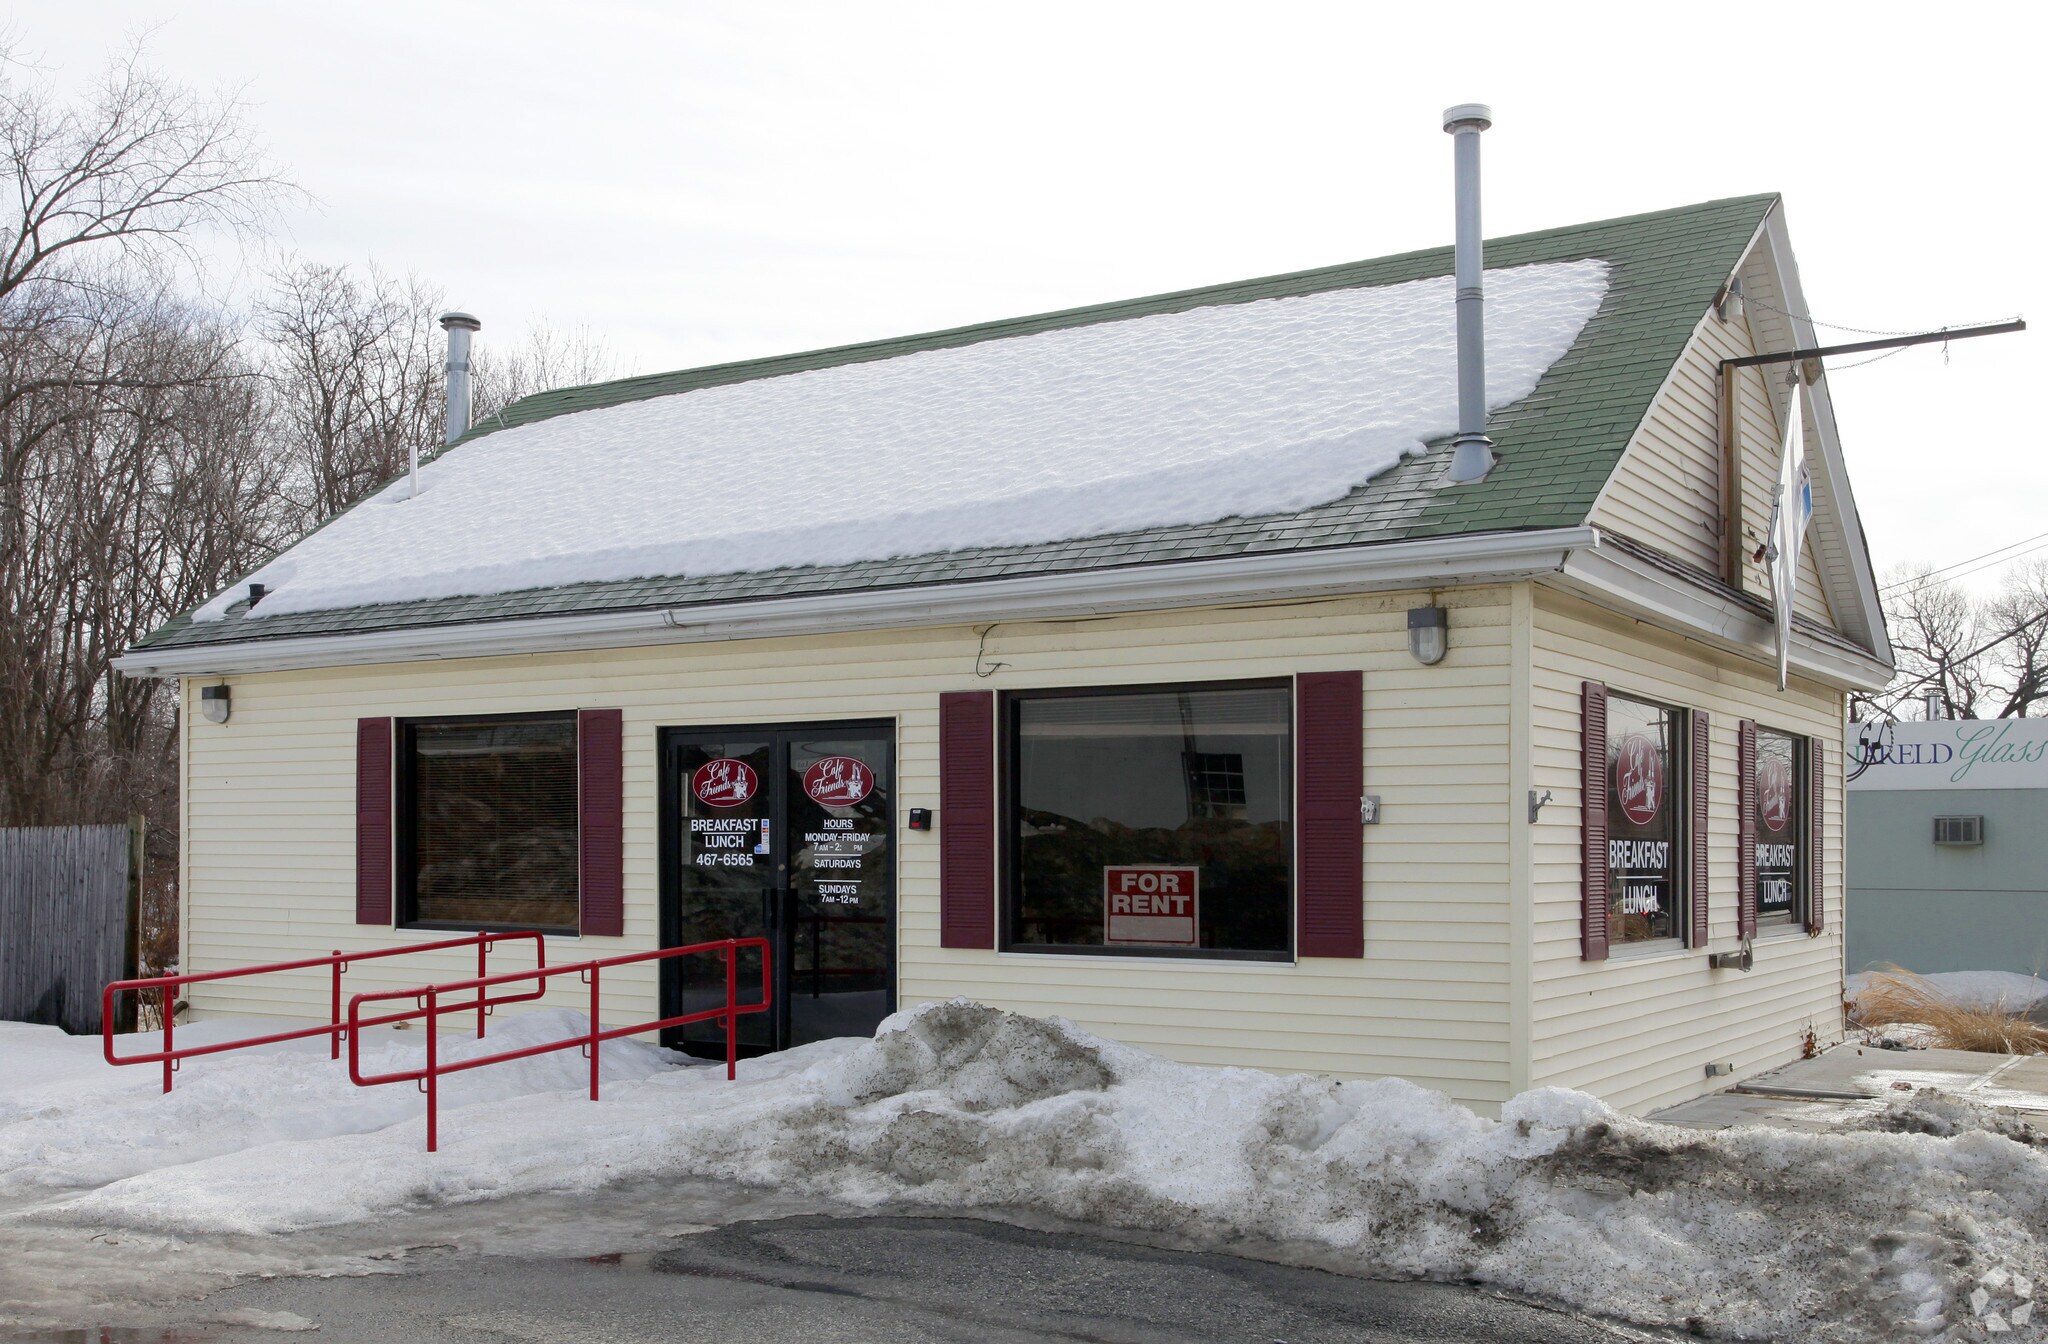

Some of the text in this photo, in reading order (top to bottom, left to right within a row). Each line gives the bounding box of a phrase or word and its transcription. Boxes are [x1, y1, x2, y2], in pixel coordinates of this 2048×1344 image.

[1950, 721, 2048, 783] Glass
[700, 777, 732, 798] Friends
[811, 775, 846, 797] Friends
[691, 818, 758, 832] BREAKFAST
[823, 819, 853, 828] HOURS
[705, 835, 744, 848] LUNCH
[696, 853, 753, 866] 467-6565
[814, 859, 861, 869] SATURDAYS
[1609, 840, 1668, 869] BREAKFAST
[1756, 844, 1794, 867] BREAKFAST
[818, 884, 857, 894] SUNDAYS
[1121, 873, 1180, 892] FOR
[1763, 880, 1787, 904] LUNCH
[1112, 895, 1190, 914] RENT
[1622, 885, 1658, 914] LUNCH
